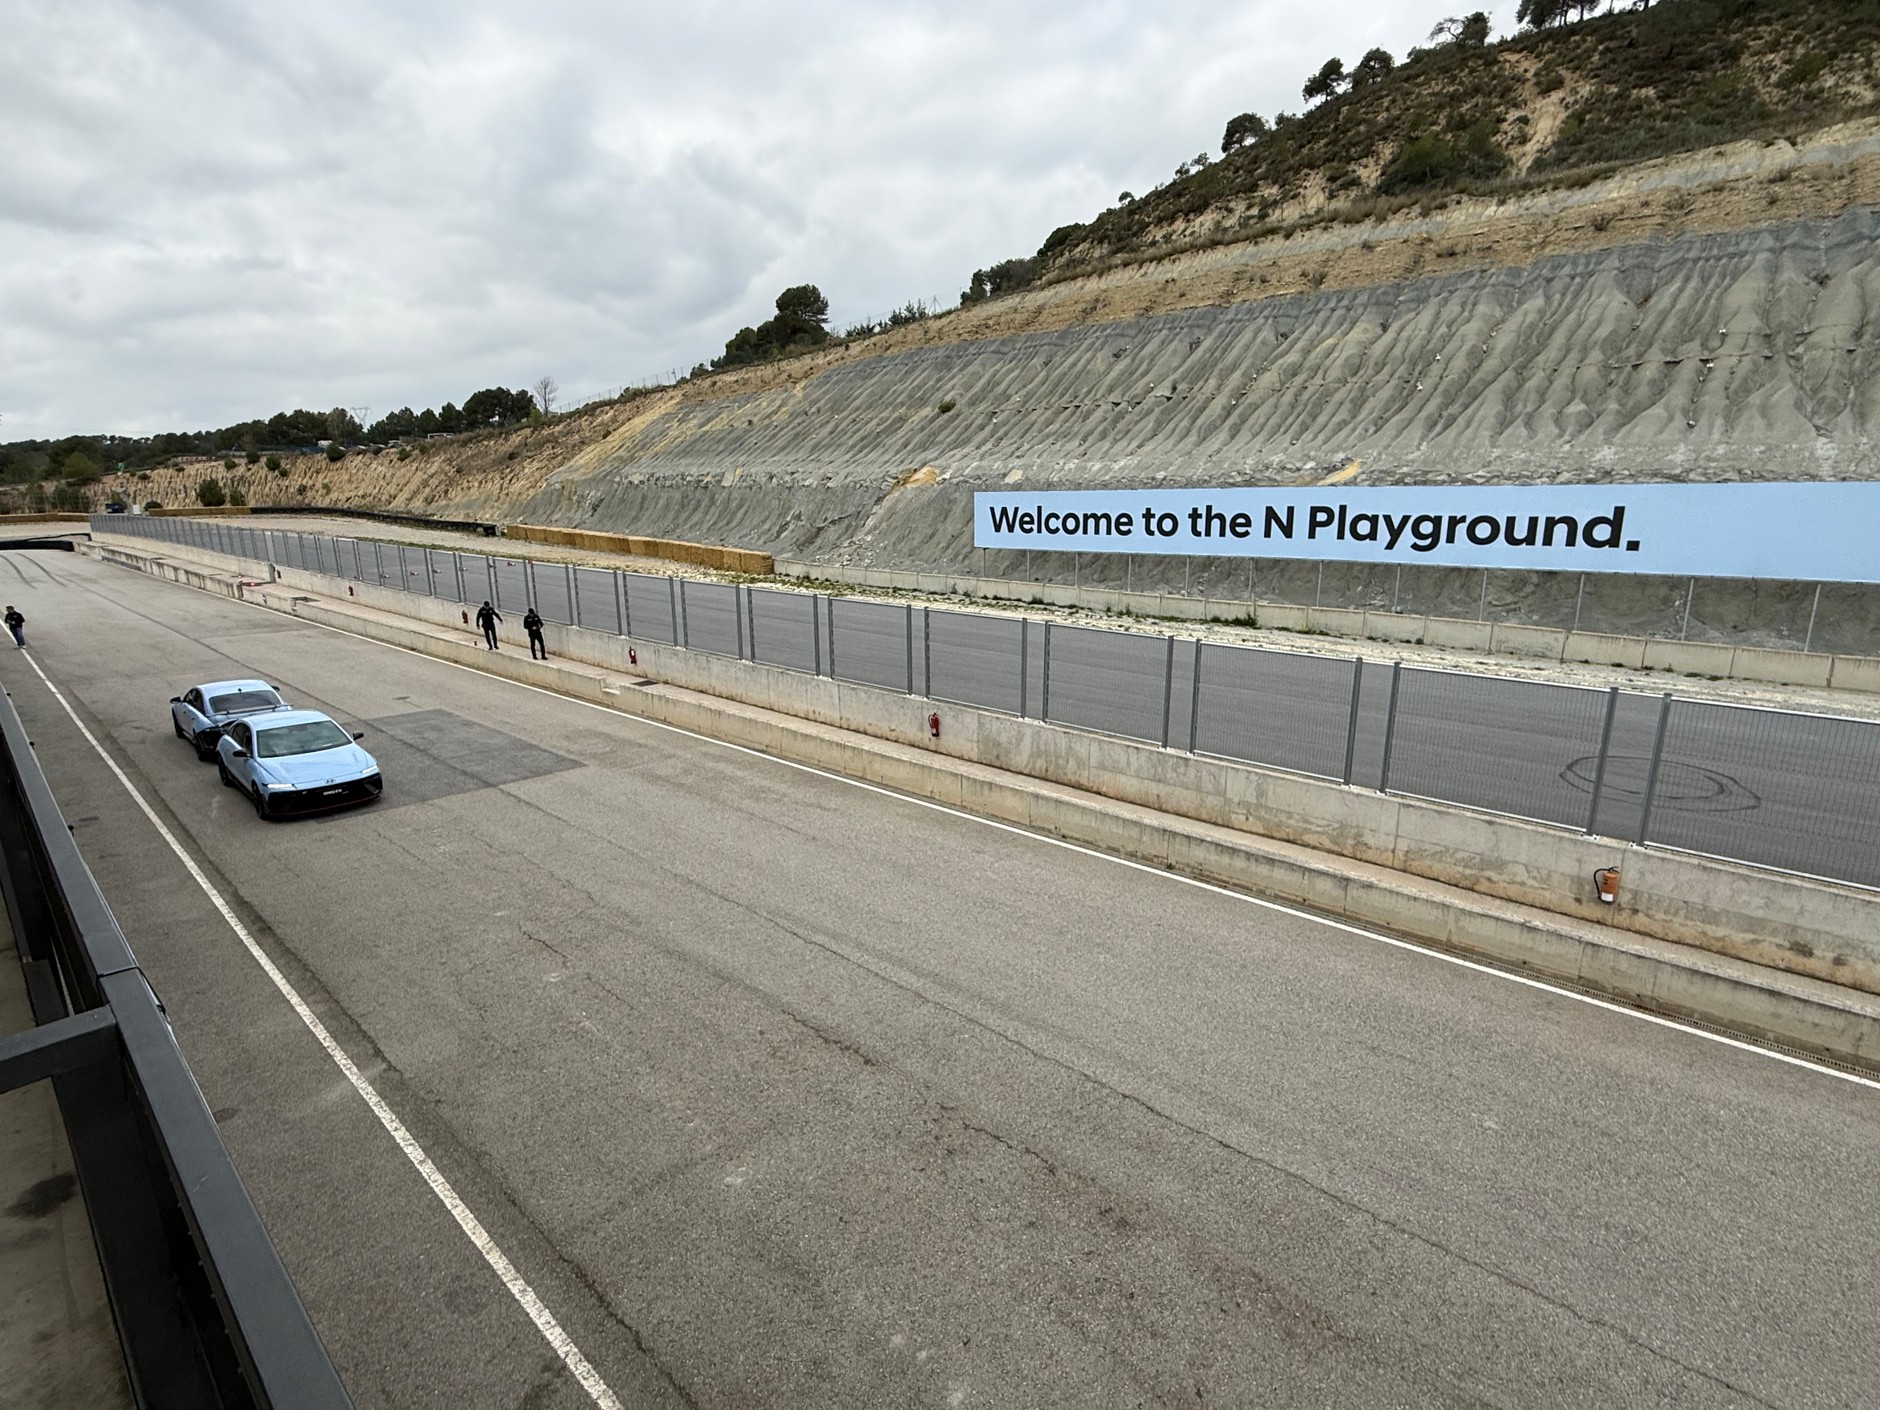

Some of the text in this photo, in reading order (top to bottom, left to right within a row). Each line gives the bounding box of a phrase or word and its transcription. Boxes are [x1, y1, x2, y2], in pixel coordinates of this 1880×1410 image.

[990, 504, 1641, 552] Welcome to the N Playground.
